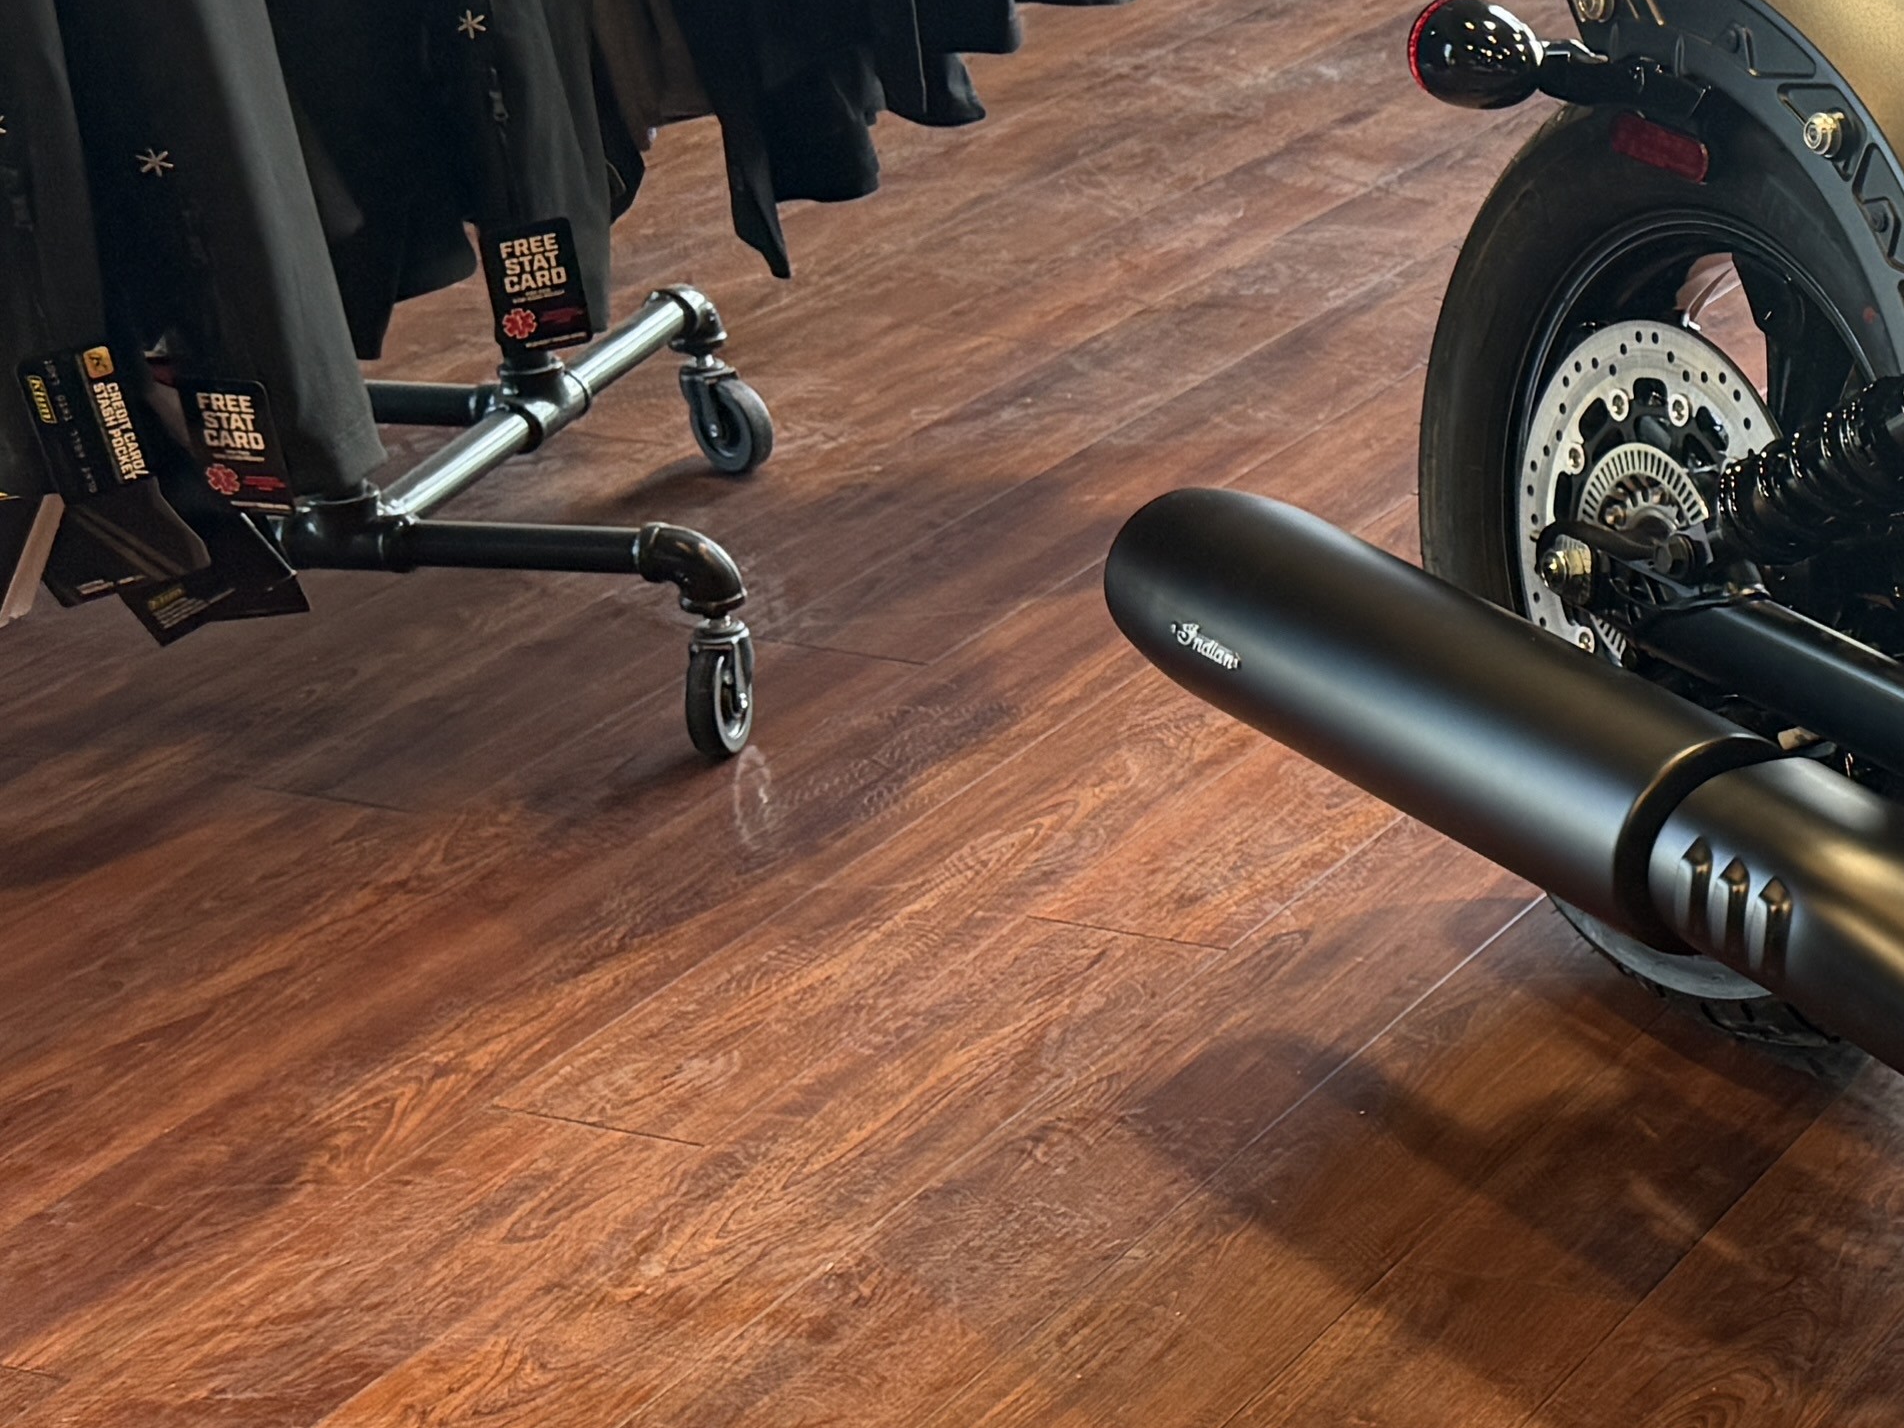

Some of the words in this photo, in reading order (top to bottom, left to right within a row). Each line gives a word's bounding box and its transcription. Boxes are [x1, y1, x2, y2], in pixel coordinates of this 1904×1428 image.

[500, 233, 559, 259] FREE
[505, 250, 559, 275] STAT
[504, 266, 567, 294] CARD
[106, 382, 133, 430] CREDIT
[196, 392, 255, 413] FREE
[93, 382, 118, 427] STASH
[109, 427, 138, 480] POCKET
[202, 411, 255, 431] STAT
[204, 429, 265, 450] CARD
[1177, 623, 1234, 670] Indian
